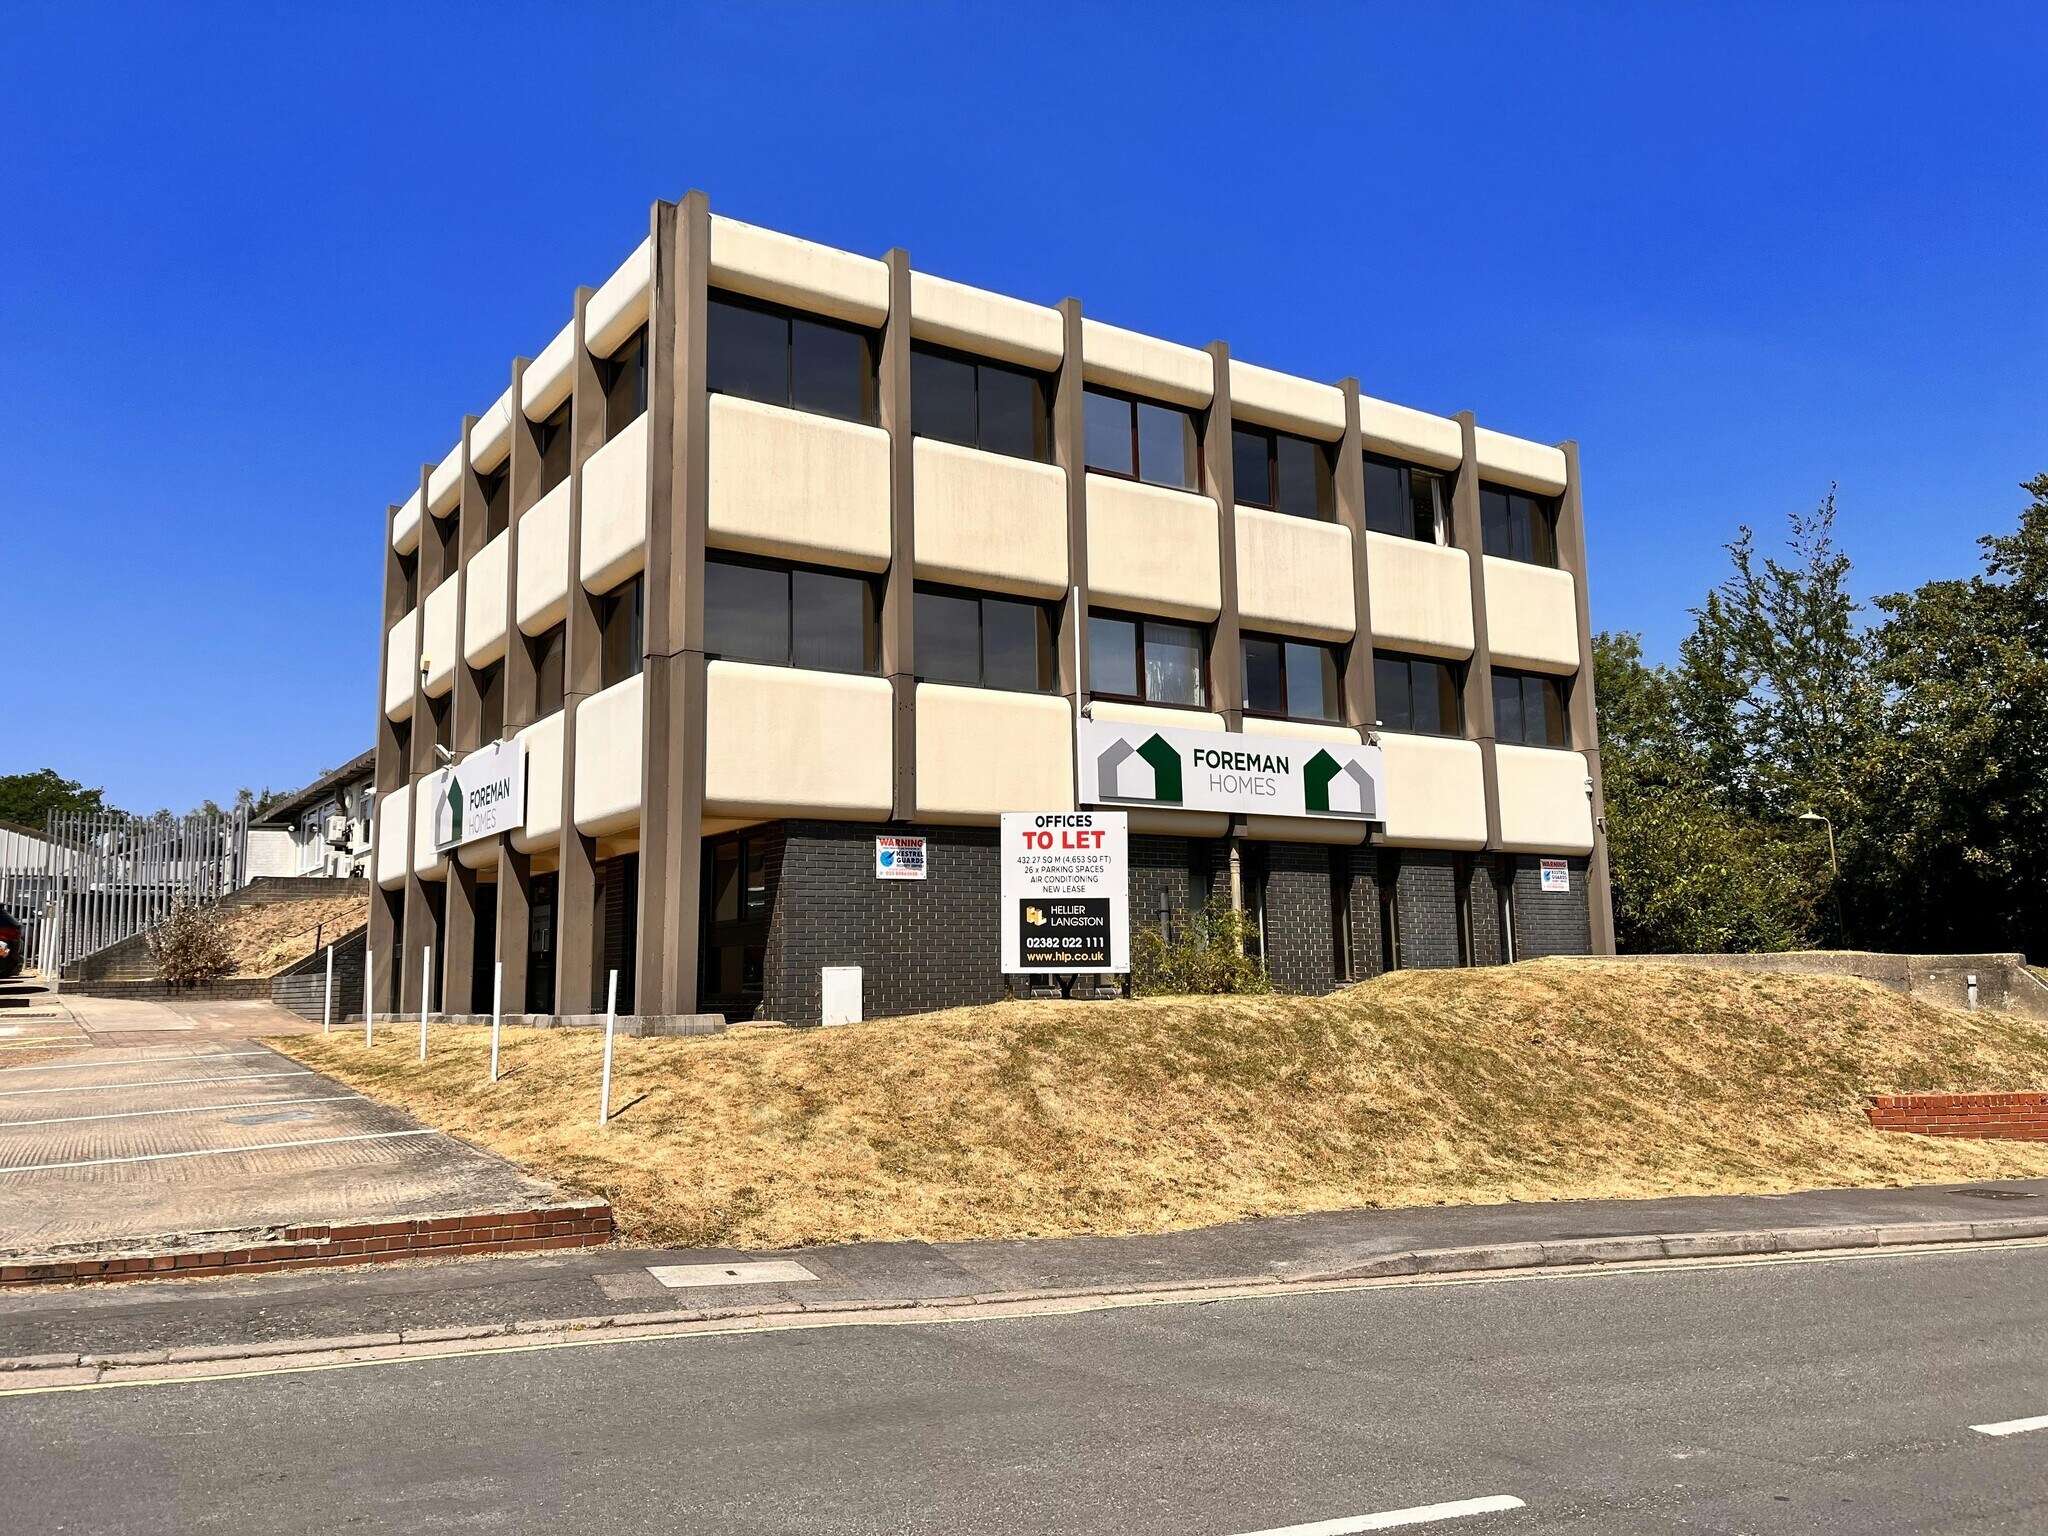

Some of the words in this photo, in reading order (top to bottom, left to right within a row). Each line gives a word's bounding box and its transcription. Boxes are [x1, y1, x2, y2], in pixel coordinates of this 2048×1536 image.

[1193, 748, 1289, 774] FOREMAN
[1210, 773, 1276, 796] HOMES
[470, 777, 510, 811] FOREMAN
[469, 808, 496, 836] HOMES
[1035, 815, 1092, 828] OFFICES
[880, 838, 923, 847] WARNING
[1022, 831, 1053, 850] TO
[1062, 831, 1105, 849] LET
[1099, 856, 1111, 864] FT)
[1051, 906, 1085, 914] HELLIER
[1051, 917, 1103, 926] LANGSTON
[1026, 938, 1059, 948] 02382
[1062, 937, 1082, 948] 022
[1087, 937, 1103, 947] 111
[1027, 951, 1104, 963] www.hlp.co.uk
